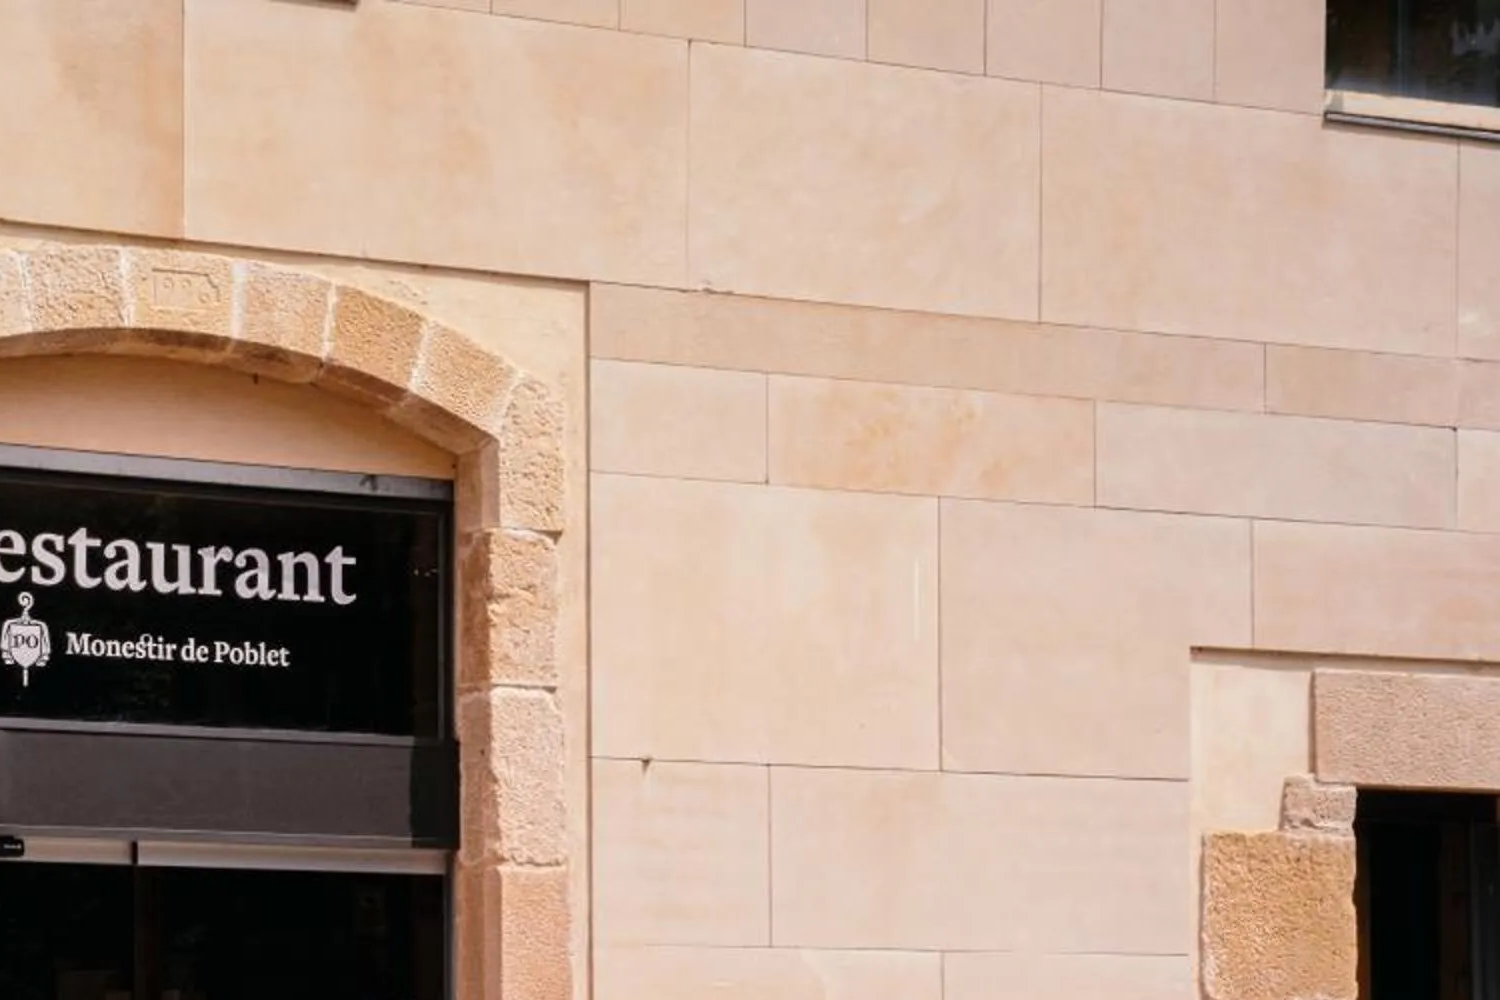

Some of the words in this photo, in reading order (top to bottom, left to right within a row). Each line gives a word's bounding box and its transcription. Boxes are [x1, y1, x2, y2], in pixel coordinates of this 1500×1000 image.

[65, 631, 177, 661] Monestir
[181, 638, 208, 662] de
[213, 641, 291, 667] Poblet
